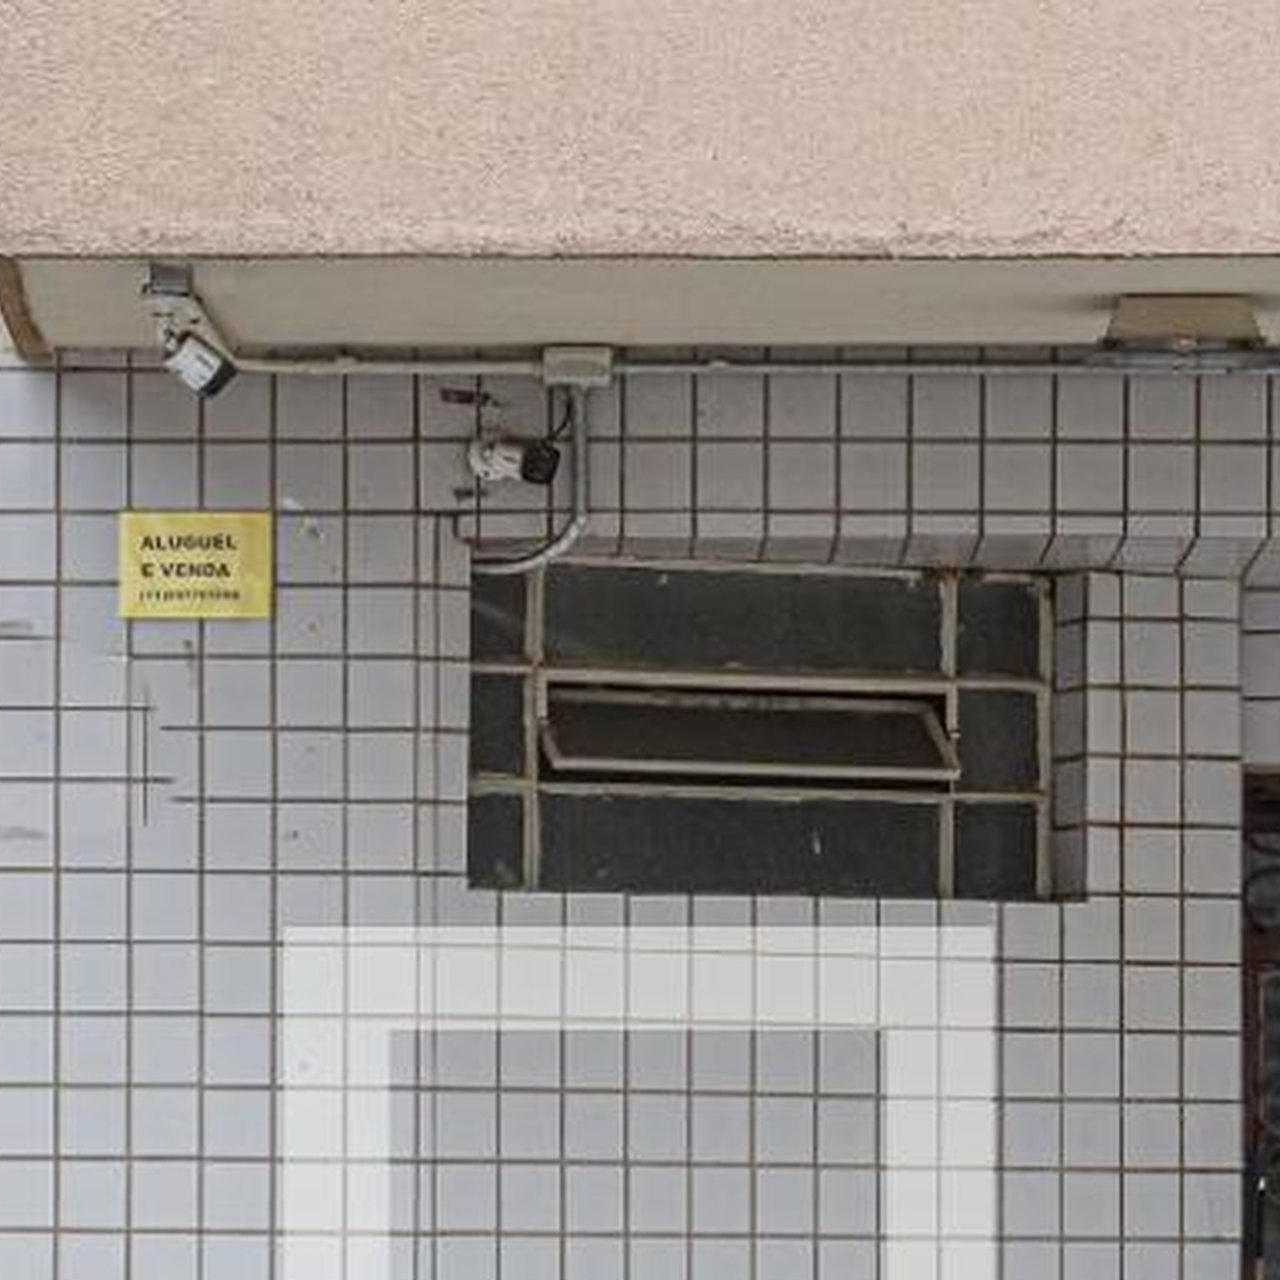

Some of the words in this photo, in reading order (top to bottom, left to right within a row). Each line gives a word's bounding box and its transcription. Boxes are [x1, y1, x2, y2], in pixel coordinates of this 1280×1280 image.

[139, 533, 238, 551] ALUGUEL
[140, 562, 154, 578] E
[159, 562, 231, 578] VENDA
